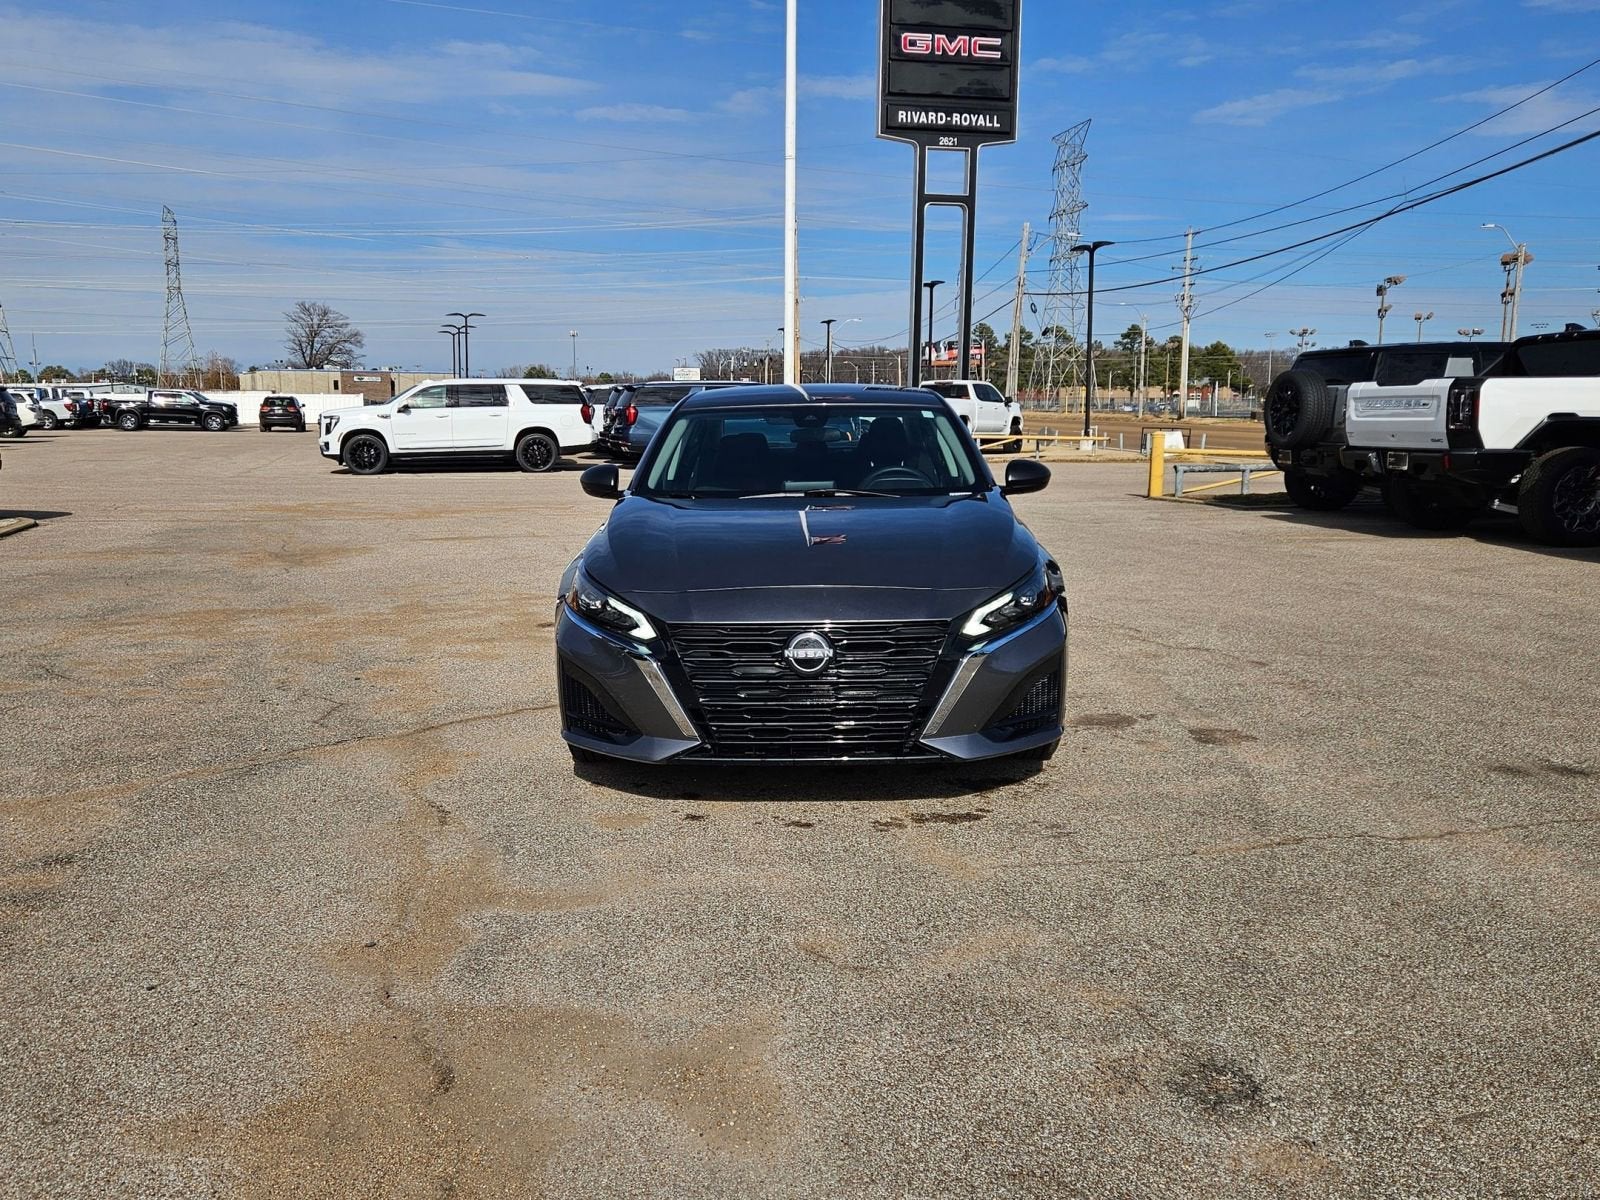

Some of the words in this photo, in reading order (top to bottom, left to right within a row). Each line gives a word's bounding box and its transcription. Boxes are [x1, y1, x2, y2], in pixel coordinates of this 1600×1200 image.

[901, 32, 1002, 59] GMC
[898, 110, 1001, 127] RIVARD-ROYALL
[939, 136, 958, 146] 2621
[784, 648, 833, 658] NISSAN
